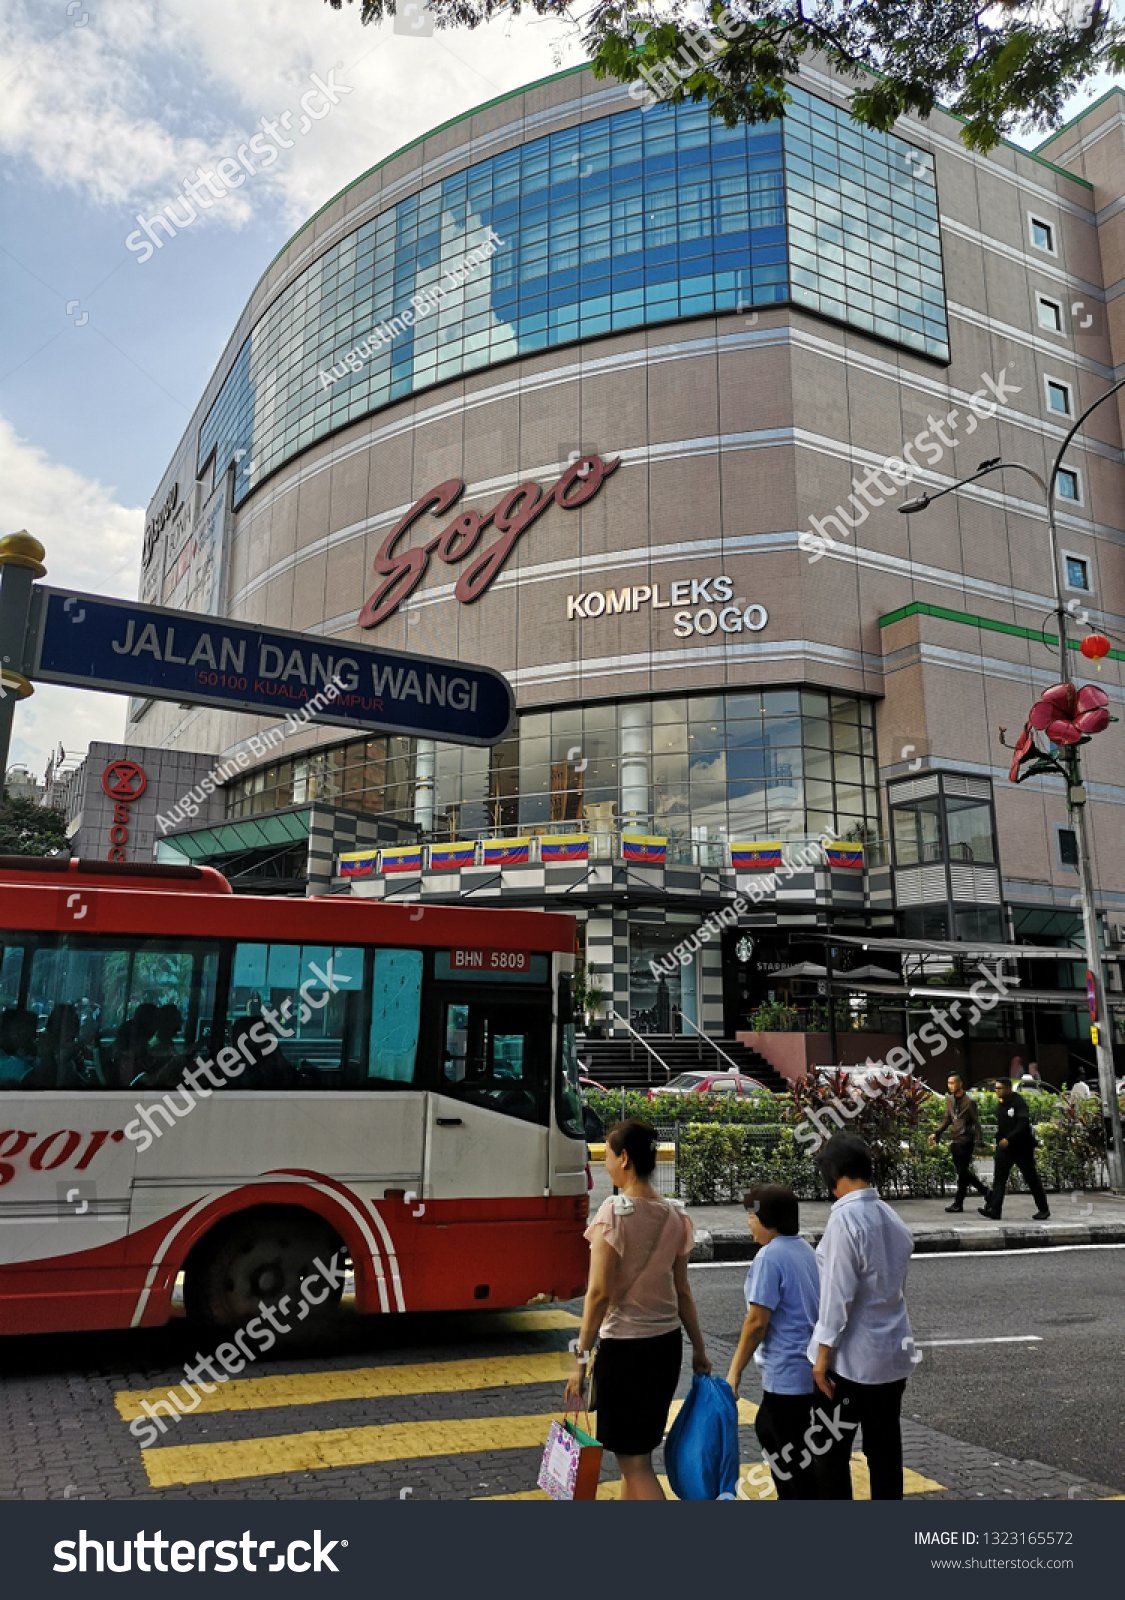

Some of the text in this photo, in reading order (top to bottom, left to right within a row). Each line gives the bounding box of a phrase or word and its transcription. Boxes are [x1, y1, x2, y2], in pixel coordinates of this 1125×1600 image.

[358, 455, 621, 629] Sogo
[566, 575, 733, 621] KOMPLEKS
[672, 603, 769, 638] SOGO
[111, 619, 479, 713] JALAN DANG WANGI
[199, 671, 248, 692] 50100
[254, 680, 309, 700] KUALA
[455, 950, 525, 969] BHN 5809
